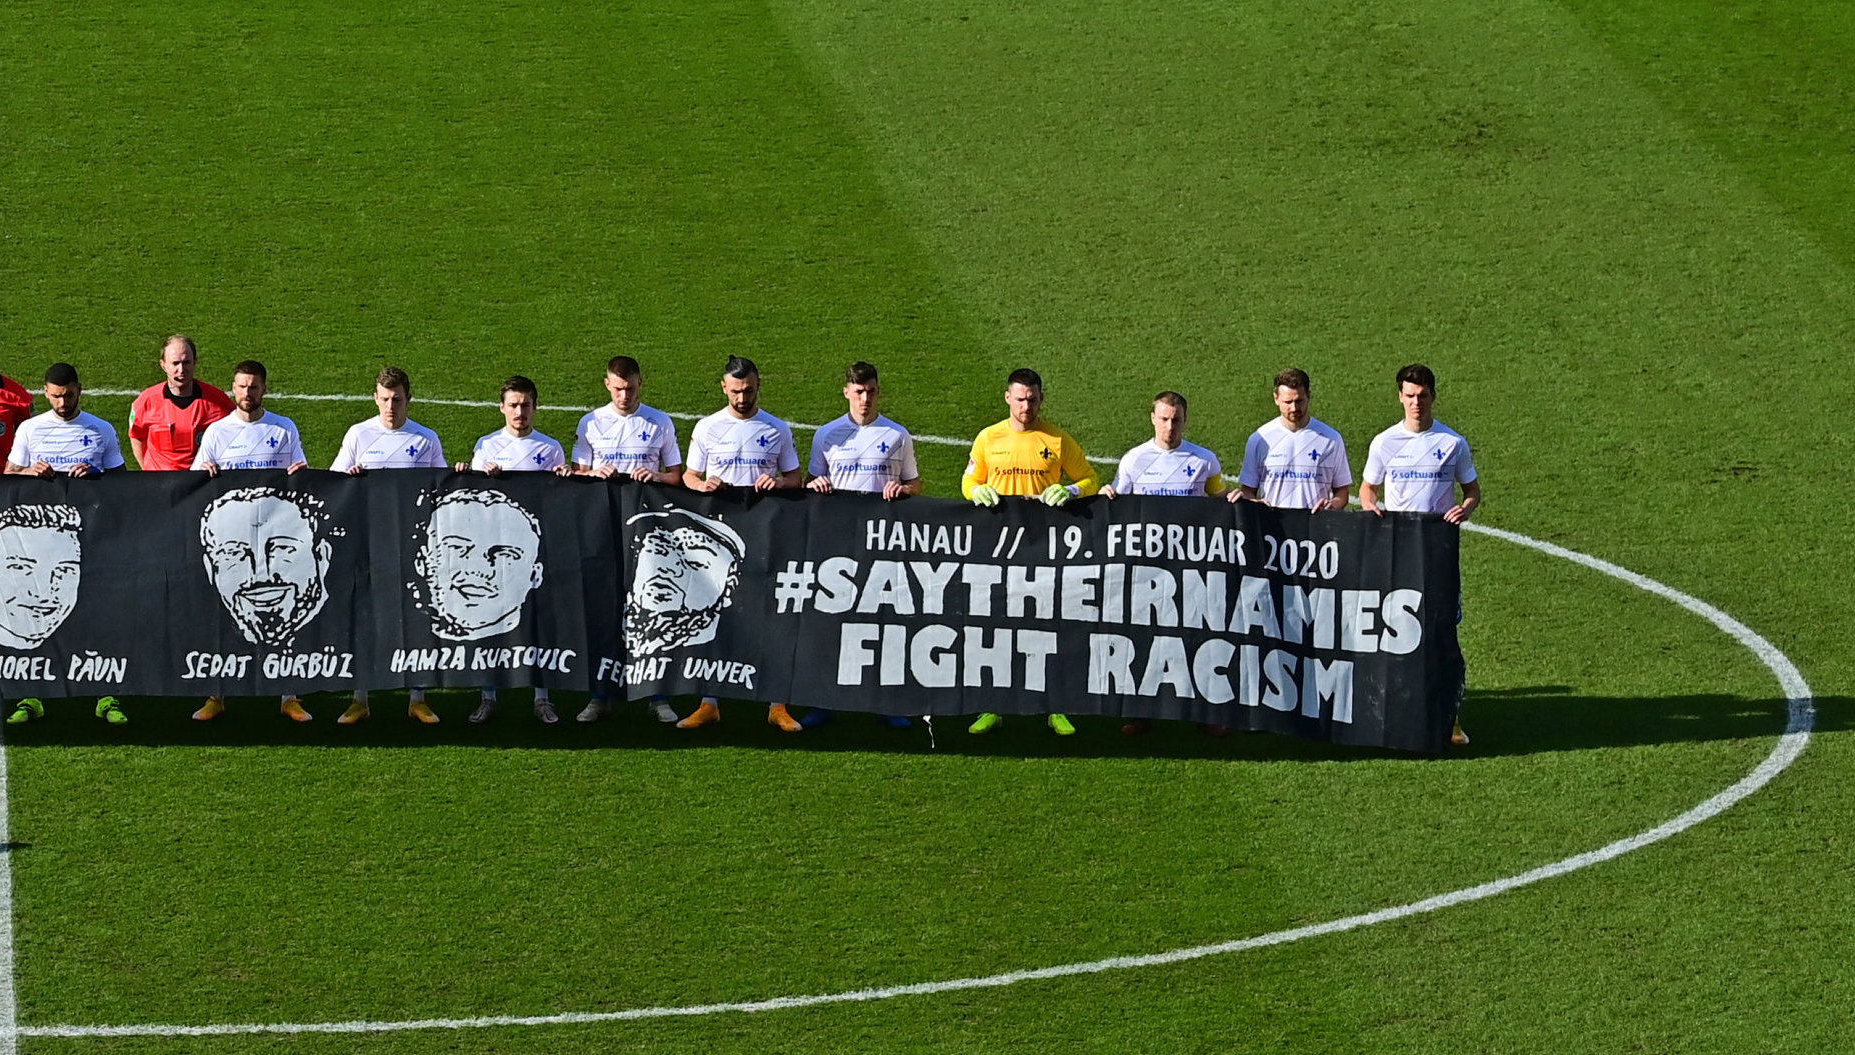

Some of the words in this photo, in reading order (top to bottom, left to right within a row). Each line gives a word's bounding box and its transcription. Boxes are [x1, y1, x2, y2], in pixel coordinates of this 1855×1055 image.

[234, 459, 278, 469] software
[605, 451, 648, 460] software
[723, 456, 766, 465] software
[844, 463, 887, 472] software
[1399, 470, 1443, 479] software
[866, 519, 973, 556] HANAU
[1048, 526, 1093, 560] 19.
[1107, 523, 1247, 566] FEBRUAR
[1264, 534, 1340, 580] 2020
[775, 556, 1423, 654] #SAYTHEIRNAMES
[181, 650, 252, 680] SEDAT
[262, 646, 354, 680] GÜRBÜZ
[390, 645, 466, 673] HAMZA
[470, 645, 577, 674] KURTOVIC
[597, 657, 673, 688] FERHAT
[683, 656, 757, 690] UNVER
[837, 622, 1058, 692] FIGHT
[1087, 633, 1354, 724] RACISM
